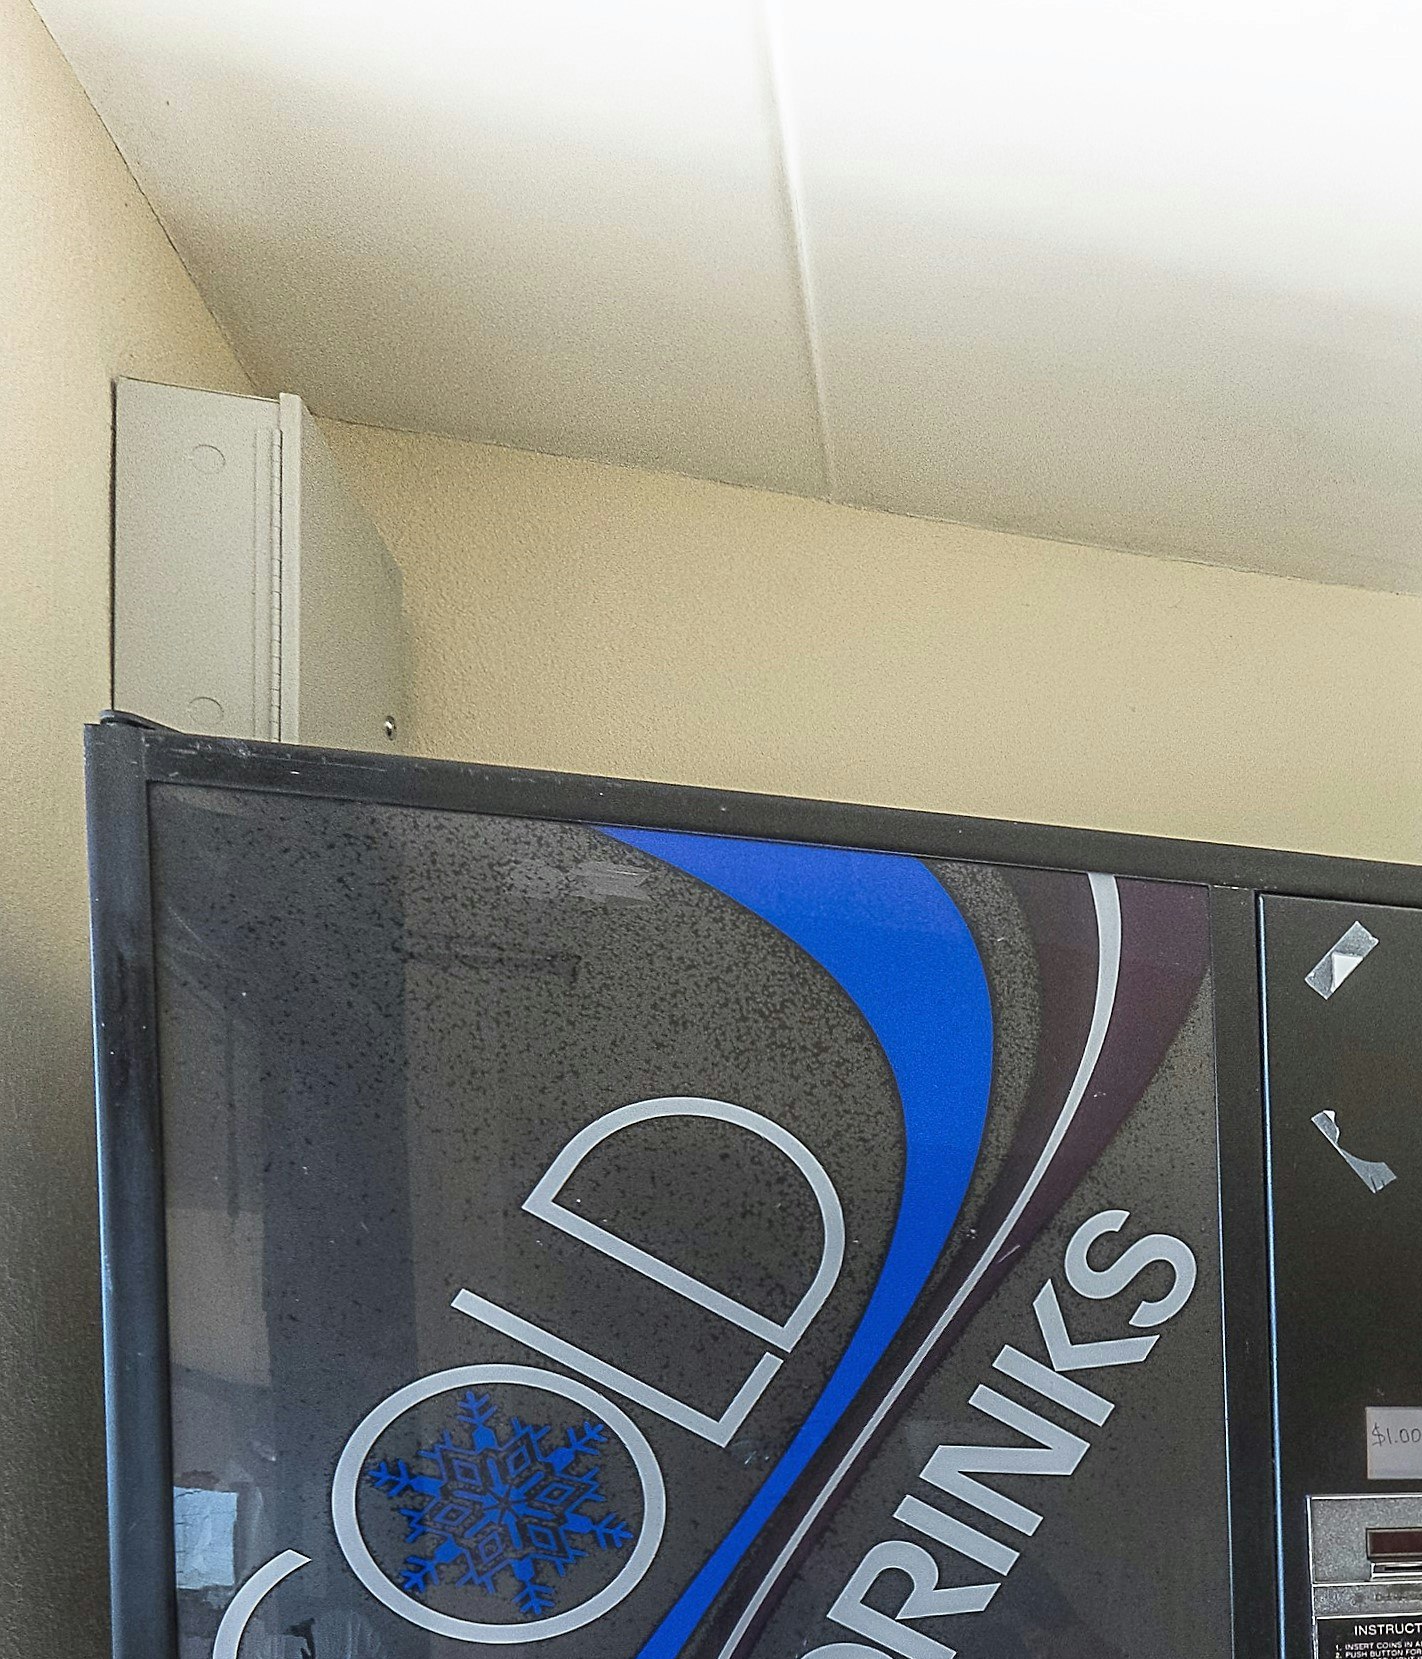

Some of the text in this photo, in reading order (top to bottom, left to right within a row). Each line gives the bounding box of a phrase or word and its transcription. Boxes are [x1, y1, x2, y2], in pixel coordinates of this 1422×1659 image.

[1371, 1422, 1422, 1446] $1.00
[1345, 1642, 1374, 1650] INSERT
[1376, 1641, 1402, 1649] COINS
[1404, 1640, 1413, 1648] IN
[1345, 1651, 1367, 1659] PUSH
[1369, 1649, 1402, 1658] BUTTON
[1405, 1648, 1421, 1656] FOR
